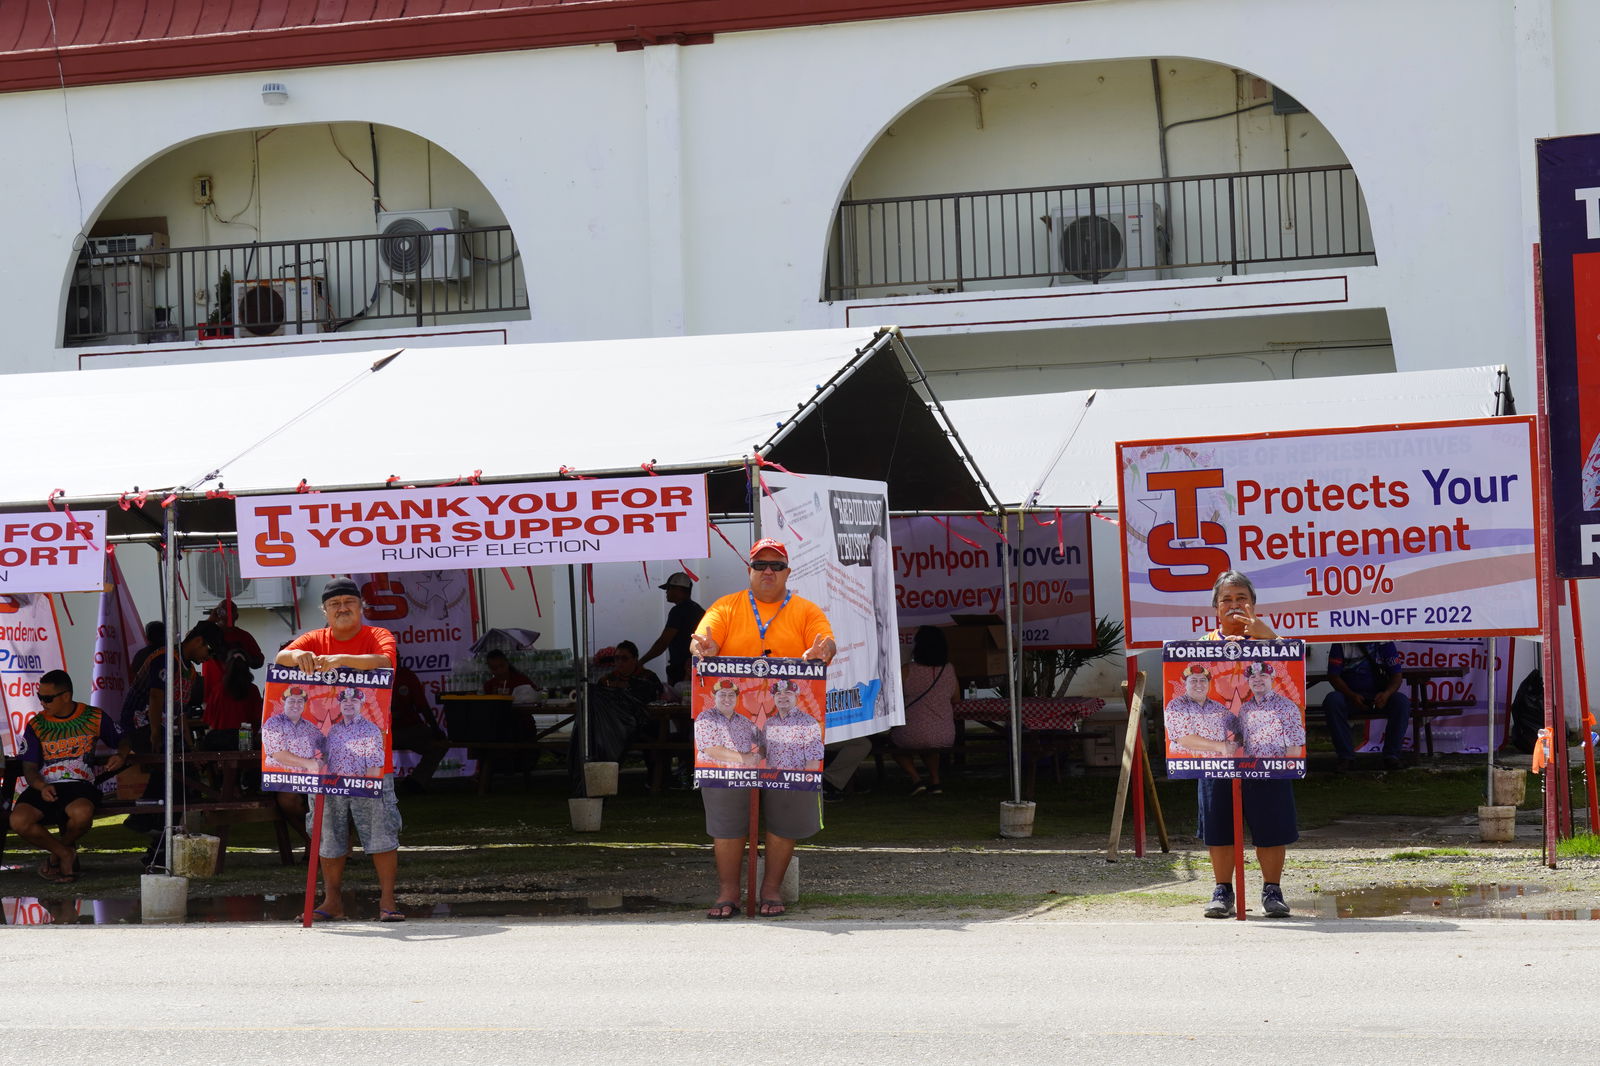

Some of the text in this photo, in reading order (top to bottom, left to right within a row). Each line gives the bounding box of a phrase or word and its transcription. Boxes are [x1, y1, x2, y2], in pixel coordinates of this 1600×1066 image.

[1236, 468, 1518, 516] Protects Your
[299, 486, 693, 523] THANK YOU FOR
[4, 521, 94, 543] FOR
[307, 511, 687, 548] YOUR SUPPORT
[1238, 517, 1472, 561] Retirement
[382, 539, 601, 561] RUNOFF ELECTION
[892, 545, 989, 577] Typhoon
[1305, 564, 1394, 596] 100%
[894, 584, 1001, 614] Recovery
[1269, 611, 1319, 629] VOTE
[1330, 607, 1418, 628] RUN-OFF
[1424, 605, 1472, 624] 2022
[1167, 646, 1299, 658] TORRES SABLAN
[271, 669, 389, 685] TORRES SABLAN
[700, 662, 823, 677] TORRES SABLAN
[695, 769, 757, 780] RESILIENCE
[783, 772, 822, 783] VISION
[1168, 760, 1235, 770] RESILIENCE
[1263, 760, 1305, 770] VISION
[263, 773, 319, 786] RESILIENCE
[343, 778, 382, 790] VISION
[292, 785, 350, 795] PLEASE VOTE
[728, 780, 790, 789] PLEASE VOTE
